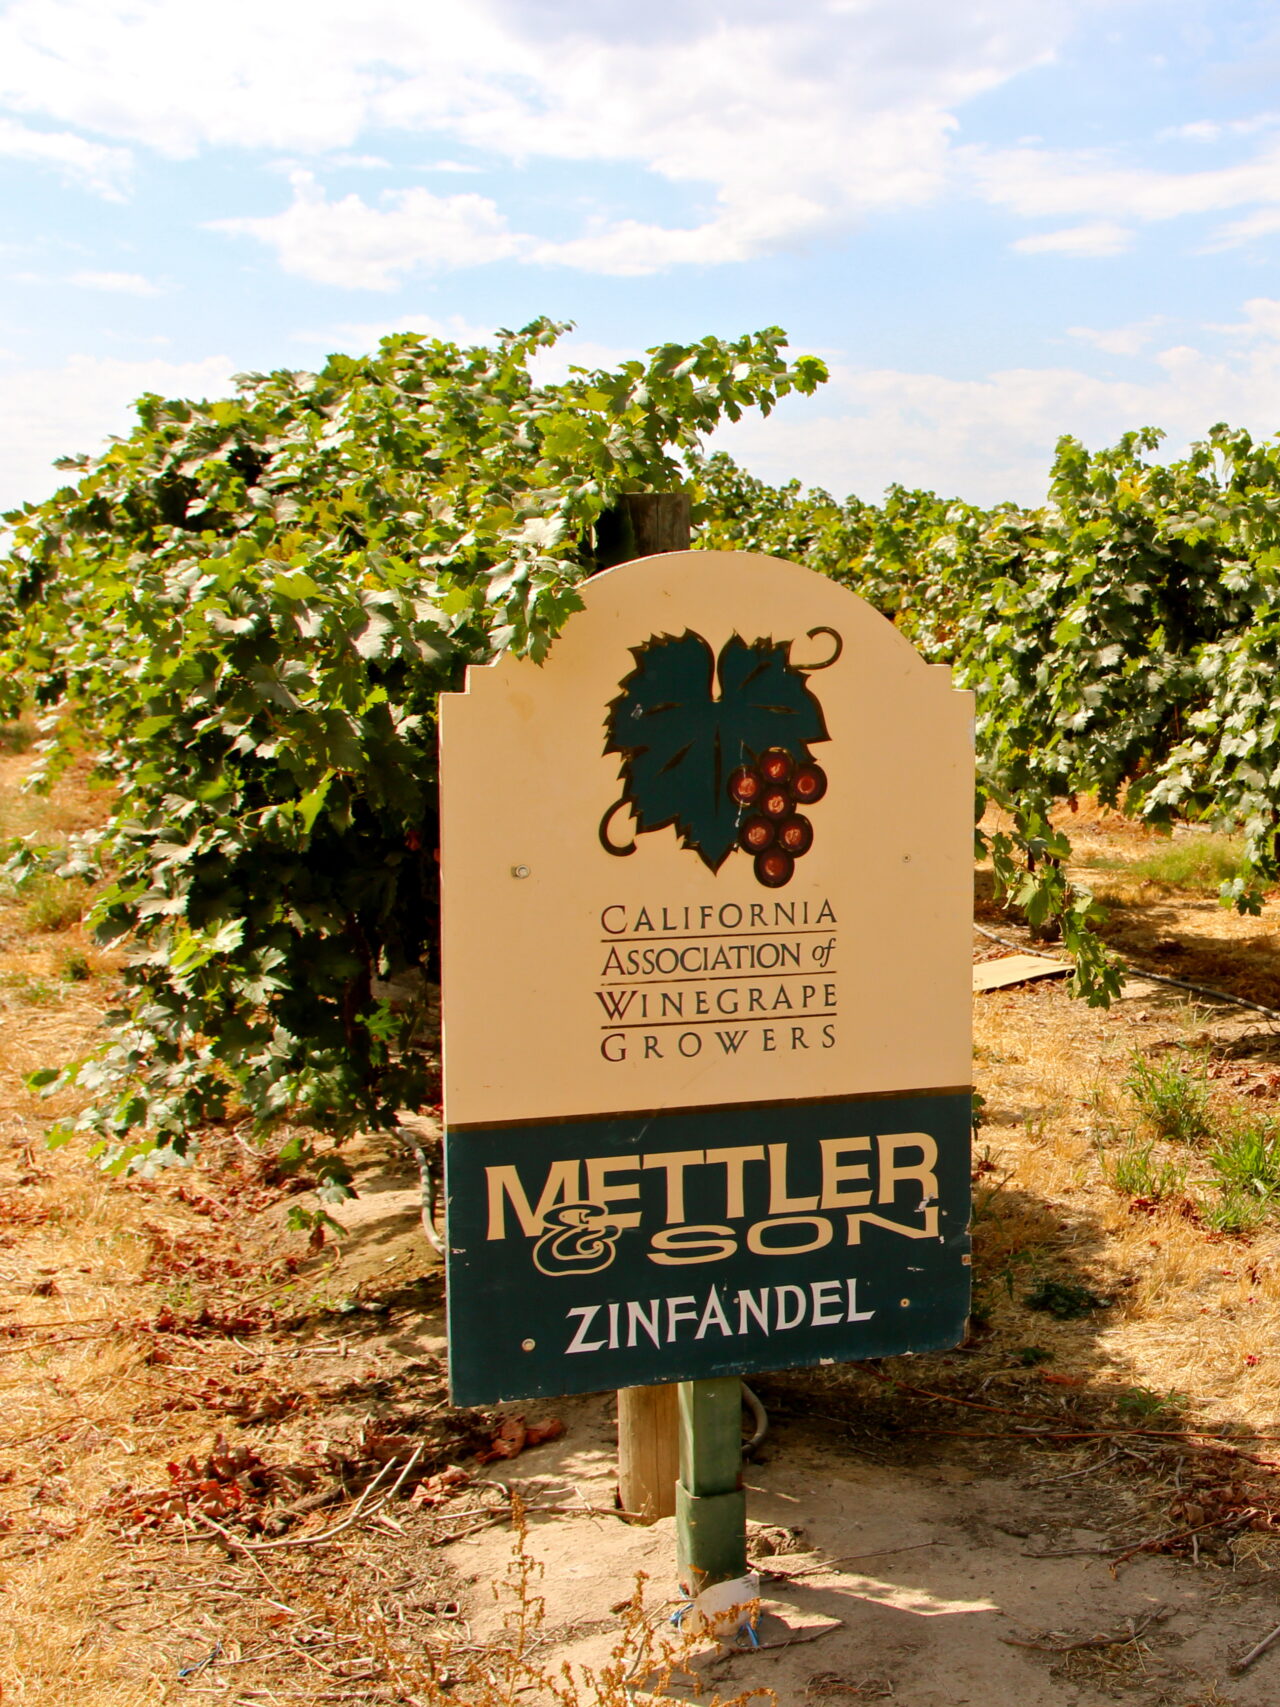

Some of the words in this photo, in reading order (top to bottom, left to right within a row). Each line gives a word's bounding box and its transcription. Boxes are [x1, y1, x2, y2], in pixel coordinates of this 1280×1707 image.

[601, 898, 838, 935] CALIFORNIA
[601, 943, 801, 976] ASSOCIATION
[811, 938, 837, 968] of
[594, 984, 838, 1021] WINEGRAPE
[600, 1024, 836, 1062] GROWERS
[484, 1132, 940, 1241] METTLER
[532, 1200, 623, 1277] &
[647, 1206, 940, 1266] SON
[564, 1278, 876, 1355] ZINFANDEL
